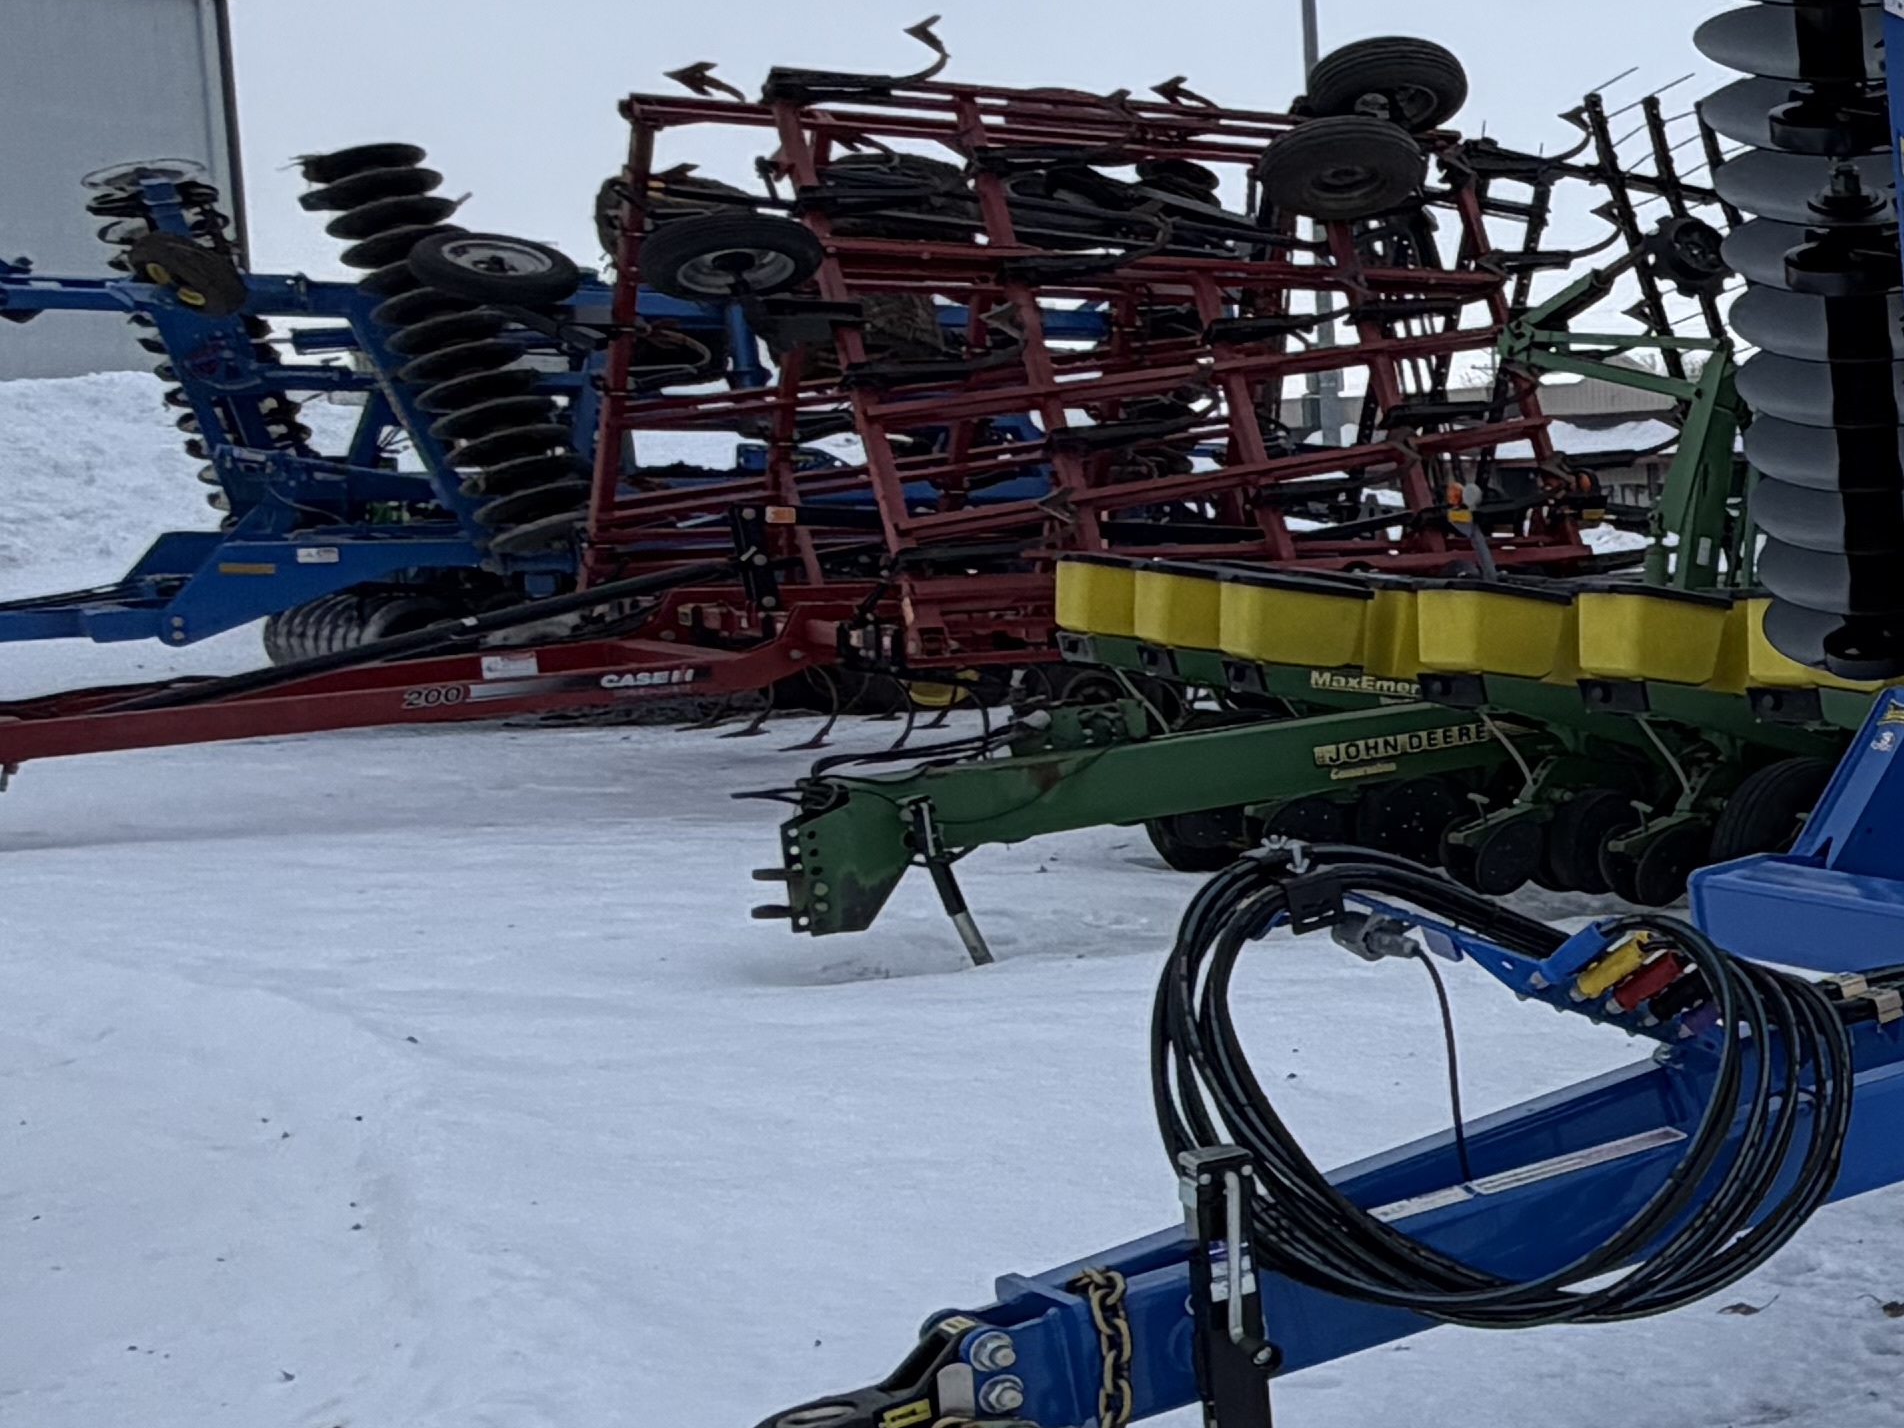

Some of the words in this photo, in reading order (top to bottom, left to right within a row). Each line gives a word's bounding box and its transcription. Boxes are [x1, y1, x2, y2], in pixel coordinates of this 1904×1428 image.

[1310, 670, 1422, 696] MaxEmer
[401, 685, 463, 709] 200
[1328, 736, 1399, 765] JOHN
[1408, 723, 1488, 752] DEERE
